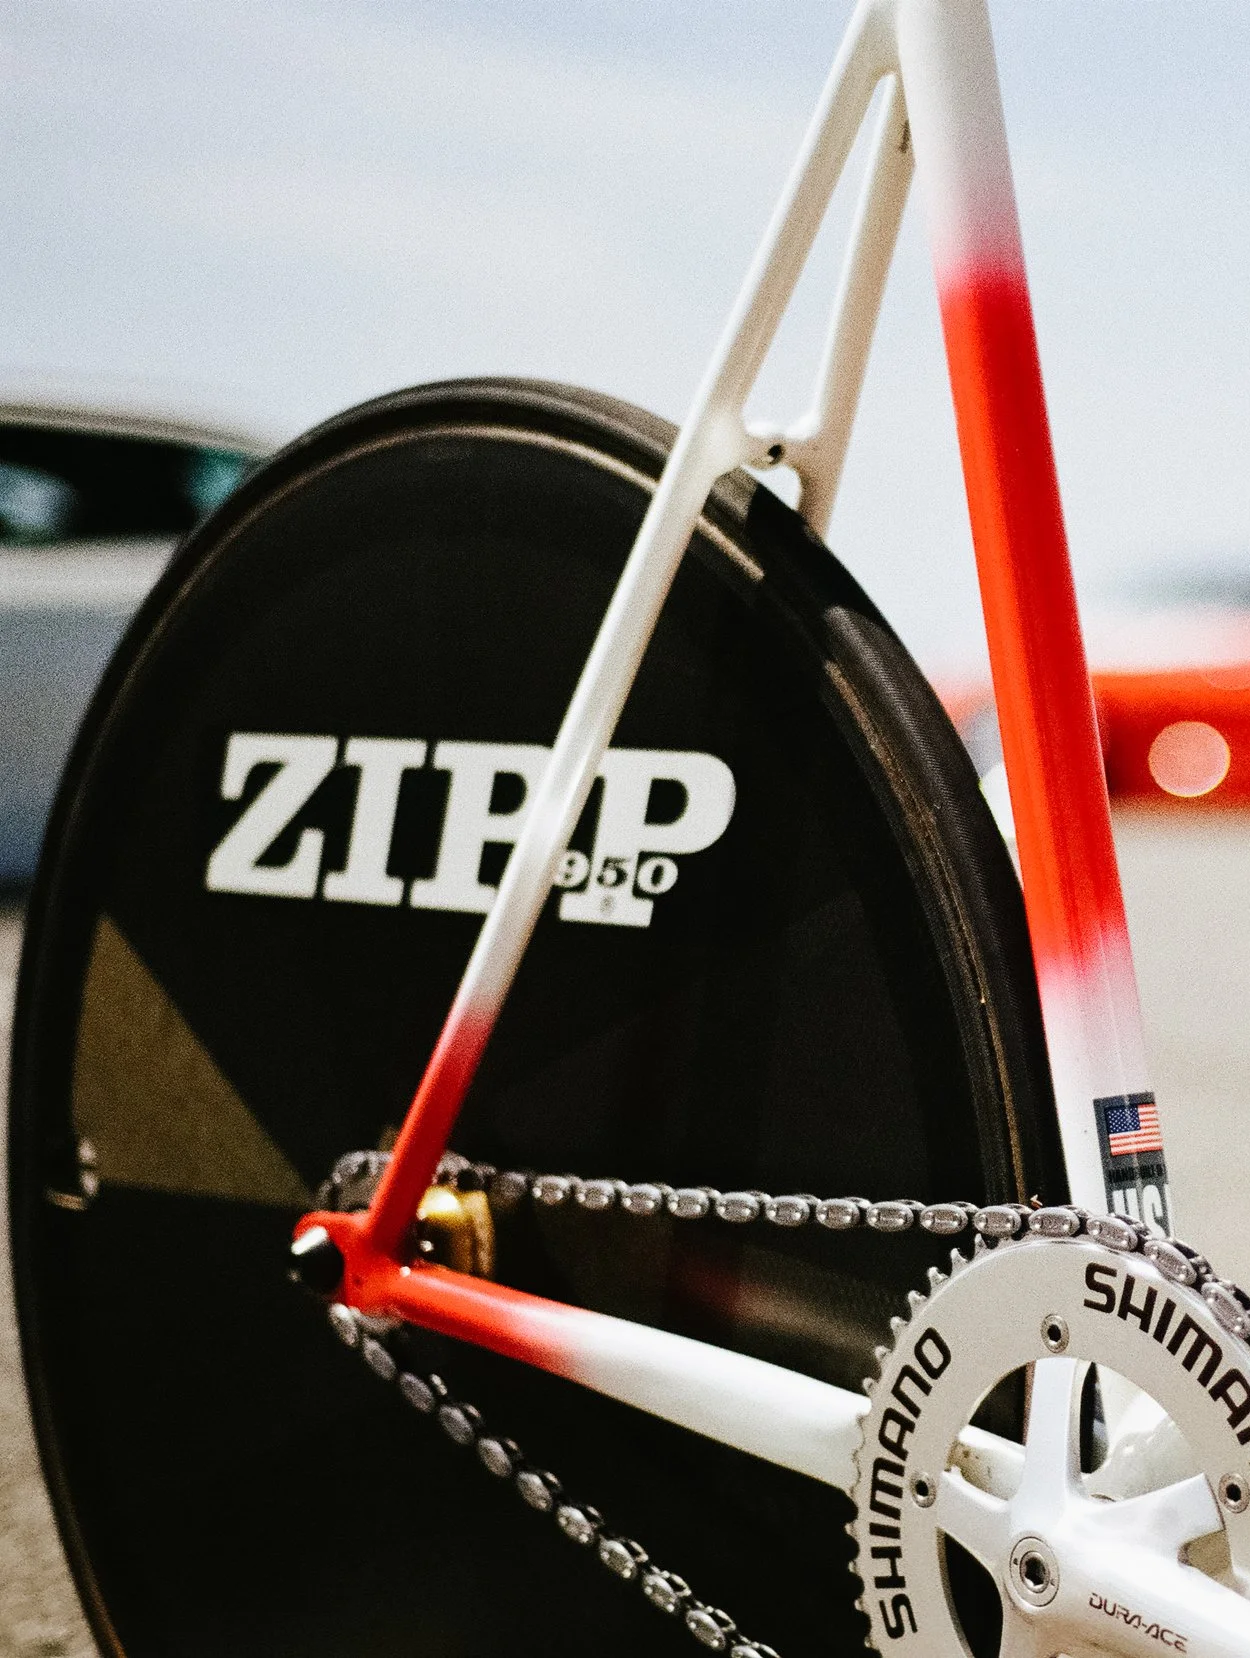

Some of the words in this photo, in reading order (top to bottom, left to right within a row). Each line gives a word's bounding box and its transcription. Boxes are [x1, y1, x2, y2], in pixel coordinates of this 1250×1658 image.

[205, 731, 738, 928] ZIPP
[552, 850, 679, 895] 950
[868, 1326, 952, 1640] SHIMANO
[1088, 1591, 1189, 1654] DURA-ACE
